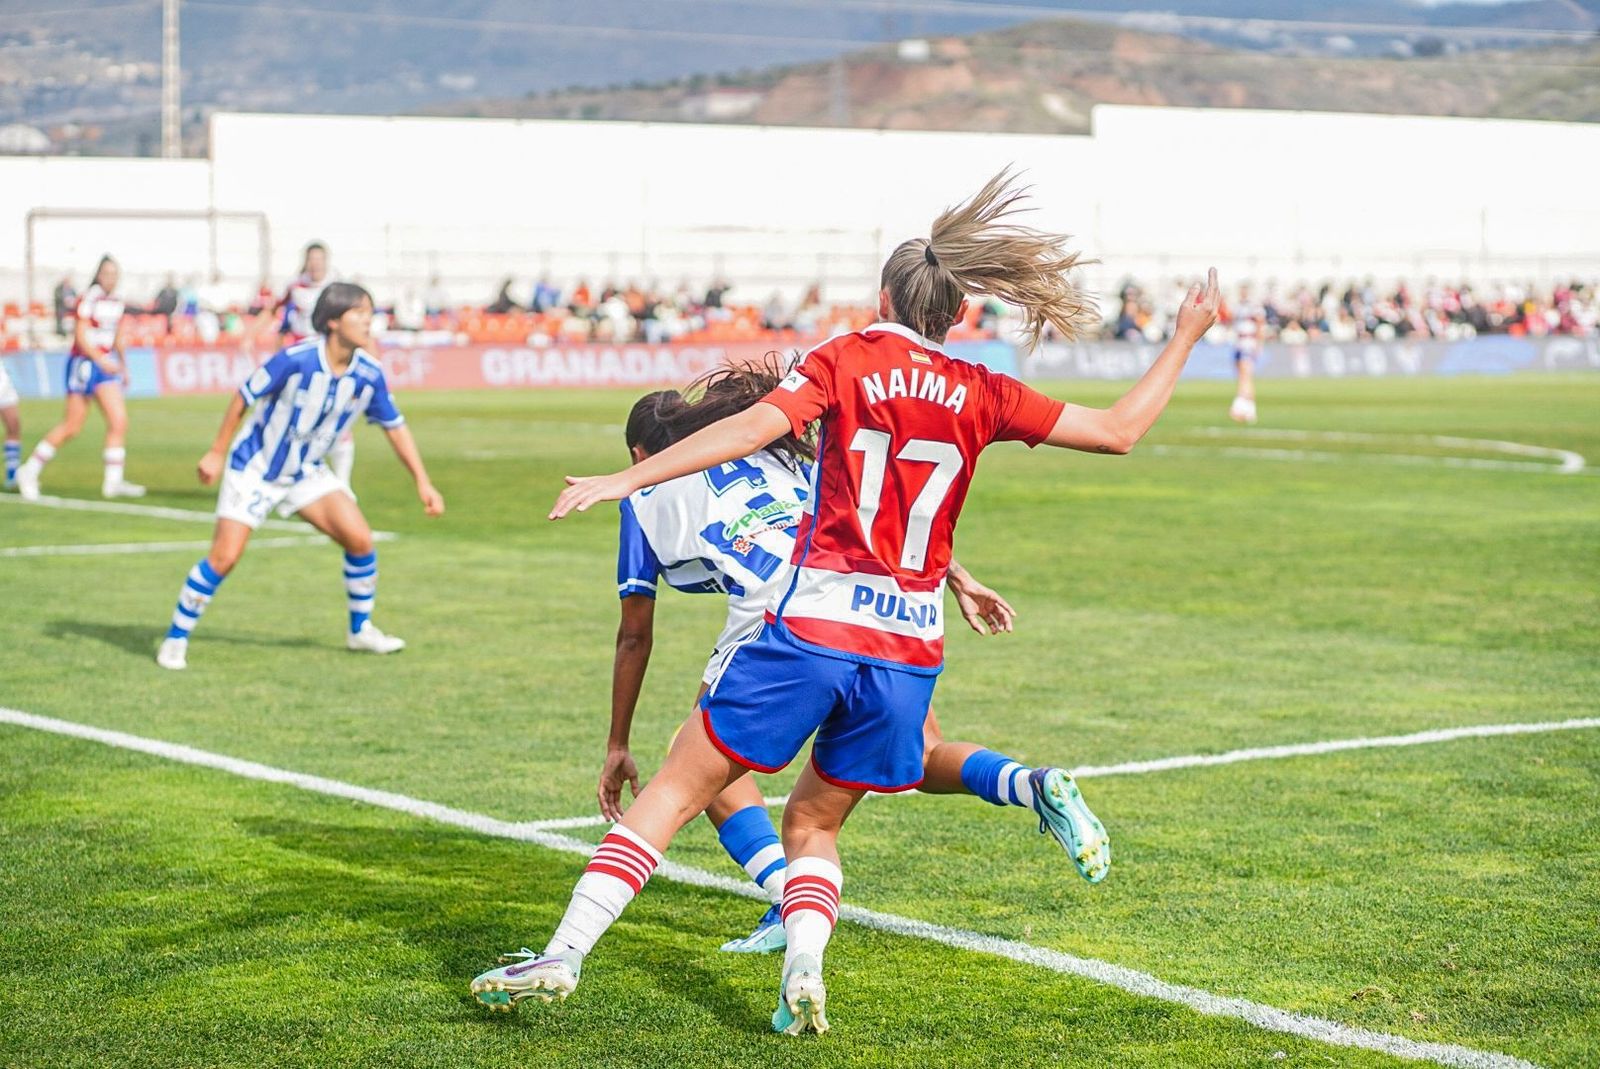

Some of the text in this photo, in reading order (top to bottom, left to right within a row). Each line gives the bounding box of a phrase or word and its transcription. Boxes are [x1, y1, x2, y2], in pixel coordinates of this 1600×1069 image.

[862, 368, 967, 415] NAIMA
[703, 457, 768, 498] 4
[849, 428, 963, 572] 17
